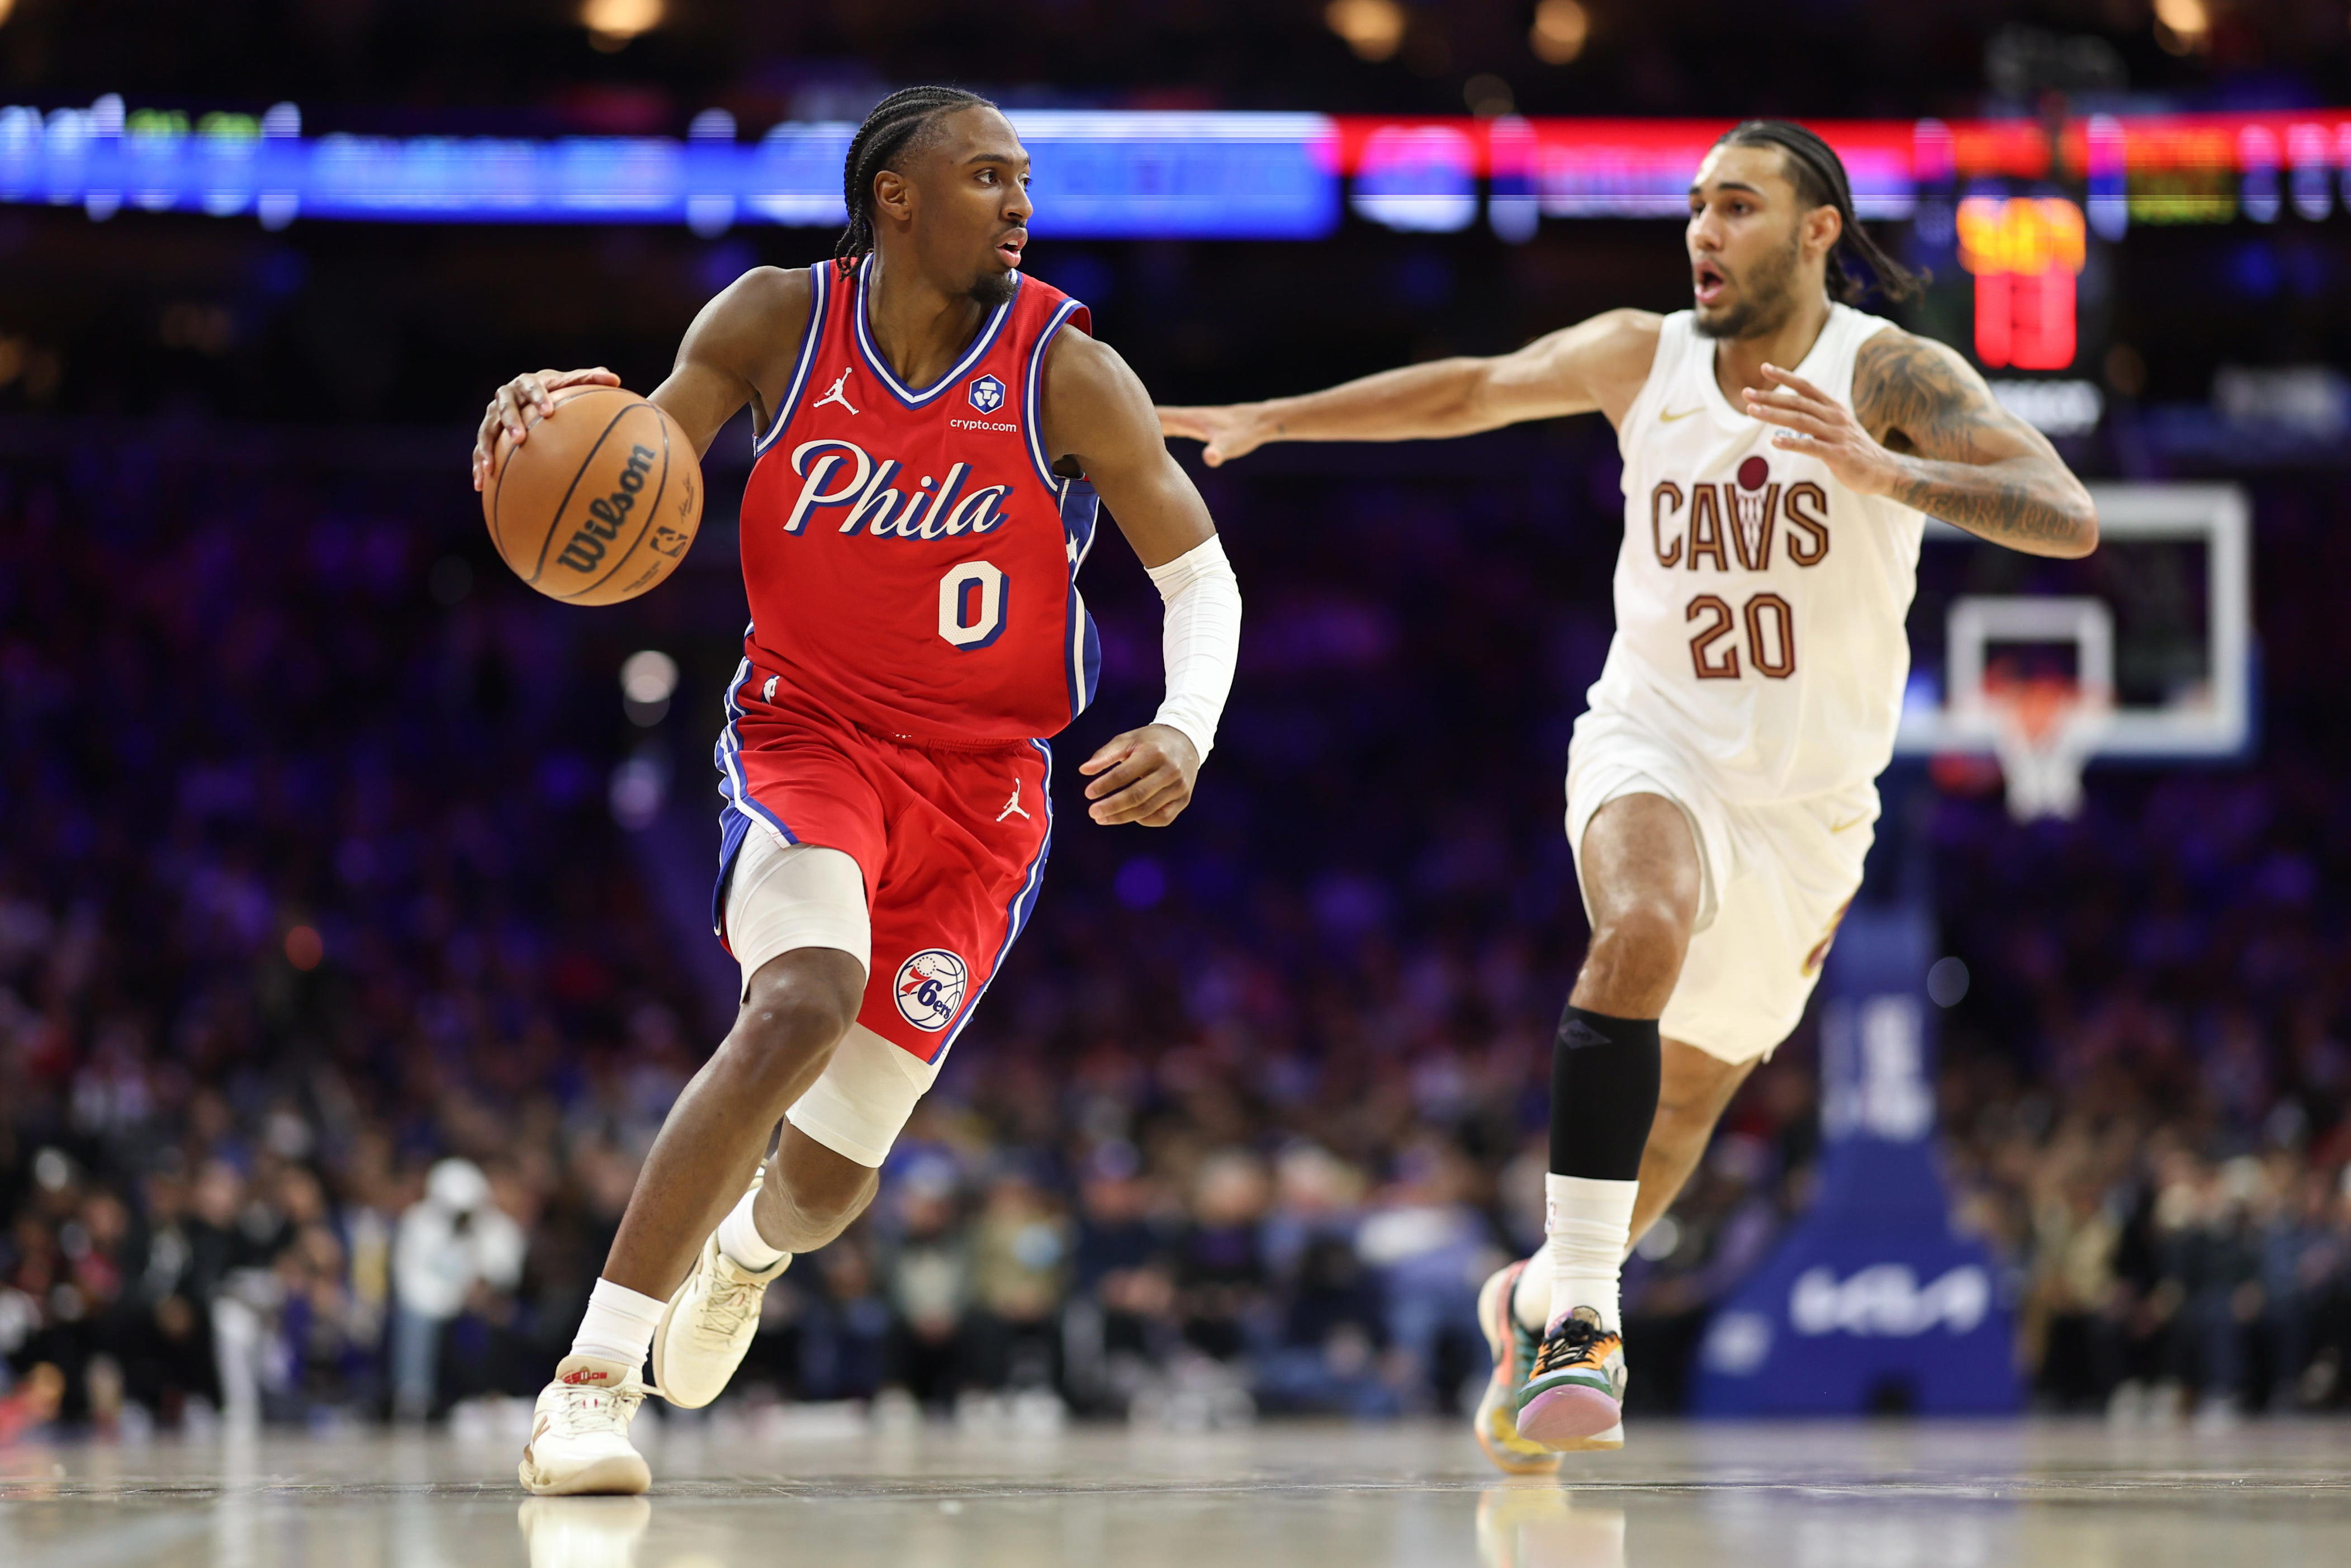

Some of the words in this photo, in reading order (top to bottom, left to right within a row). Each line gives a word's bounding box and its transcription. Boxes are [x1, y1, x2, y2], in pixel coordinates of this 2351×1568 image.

[950, 419, 1017, 433] crypto.com
[557, 443, 656, 574] Wilson
[783, 439, 1015, 542] Phila
[1651, 480, 1829, 571] CAVS
[938, 560, 1010, 652] 0
[1685, 593, 1796, 680] 20
[900, 965, 952, 1020] 76ers
